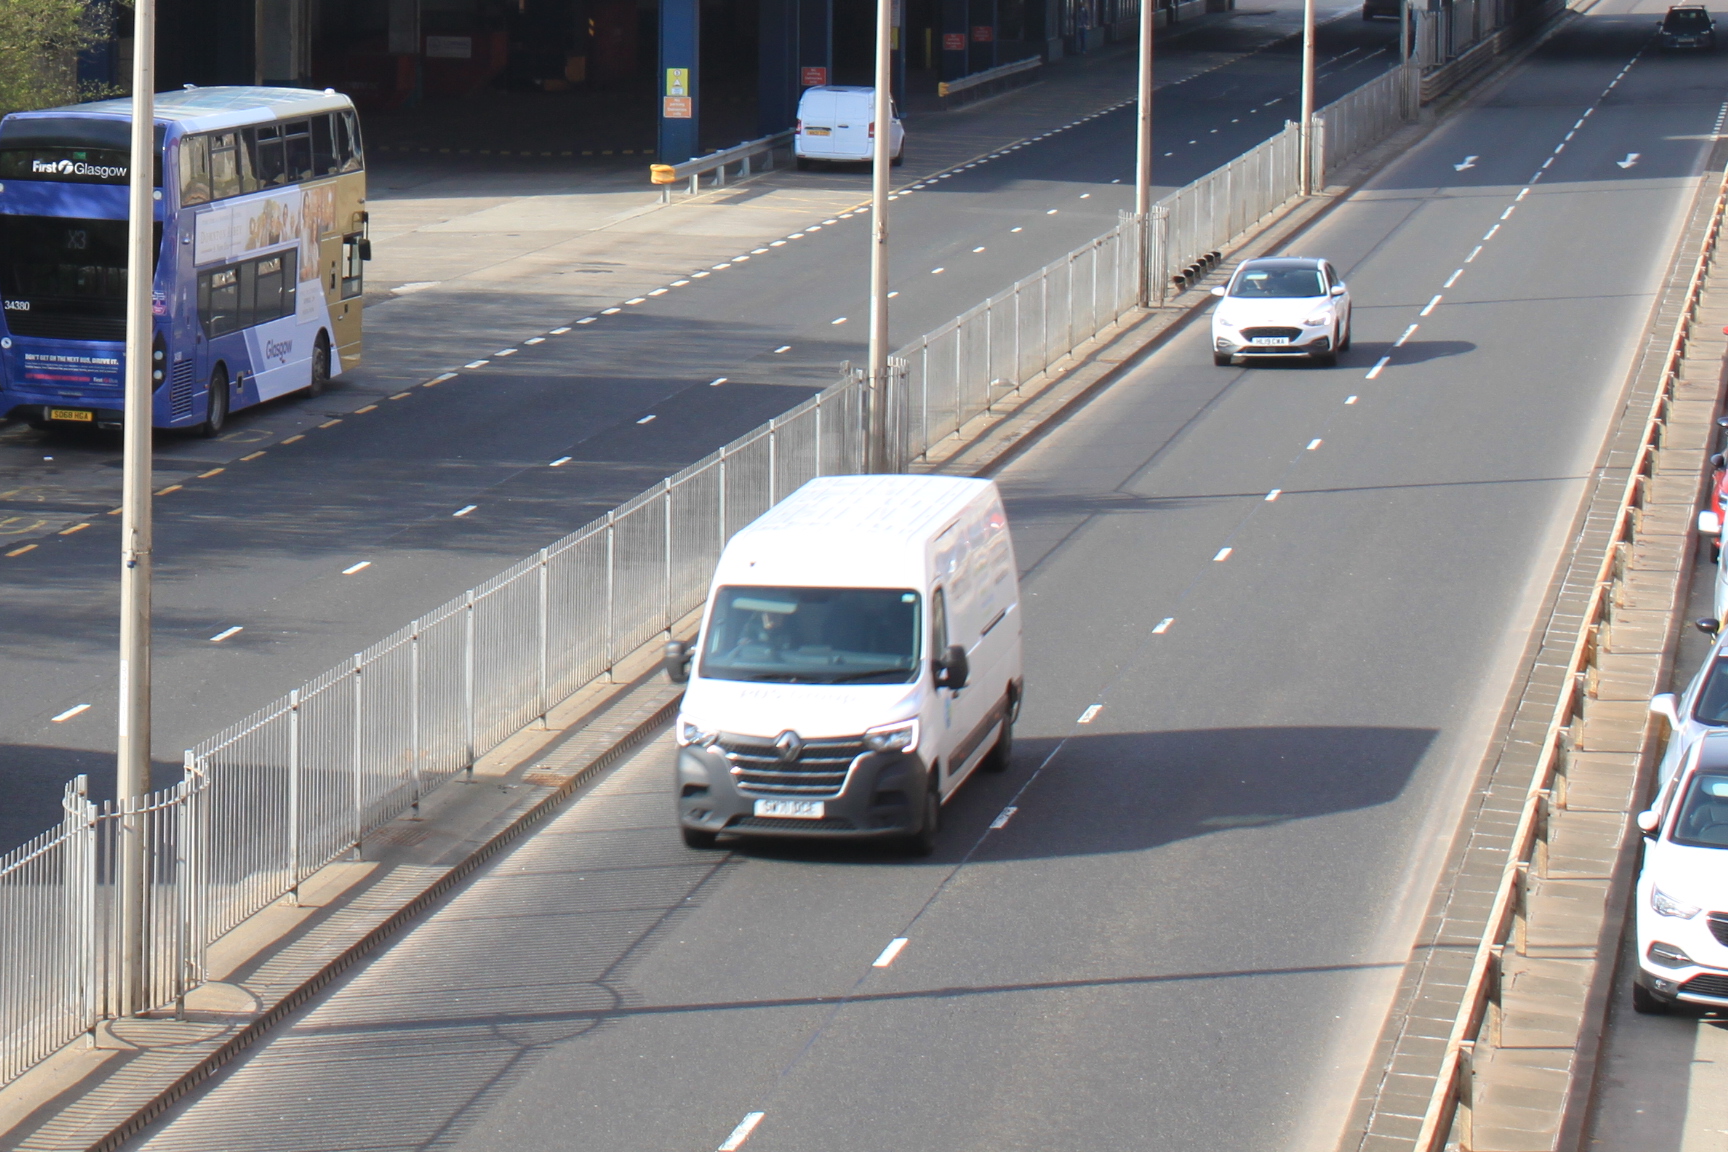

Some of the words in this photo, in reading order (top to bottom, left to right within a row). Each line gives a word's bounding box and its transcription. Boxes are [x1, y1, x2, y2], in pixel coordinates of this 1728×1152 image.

[32, 160, 57, 173] First
[74, 163, 127, 179] Glasgow
[4, 300, 30, 311] 34380
[266, 339, 293, 361] Glasgow
